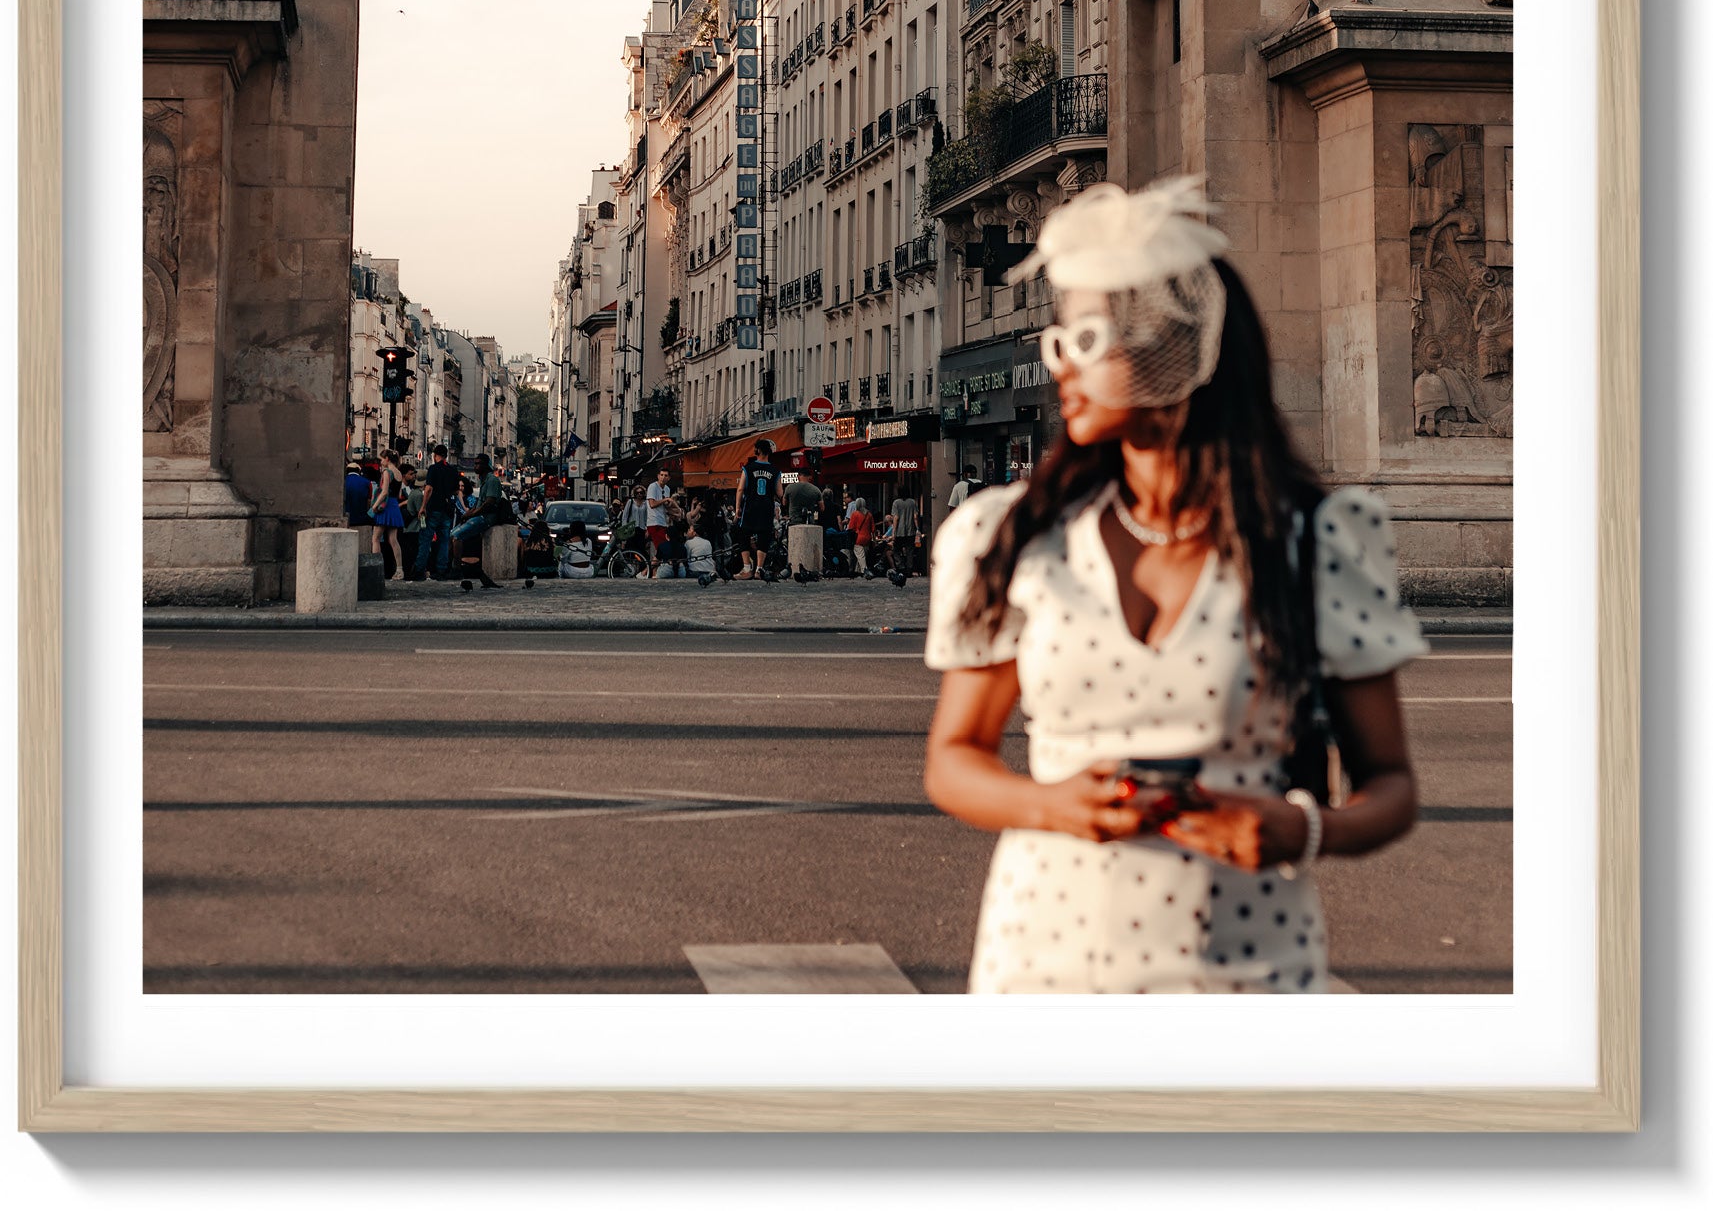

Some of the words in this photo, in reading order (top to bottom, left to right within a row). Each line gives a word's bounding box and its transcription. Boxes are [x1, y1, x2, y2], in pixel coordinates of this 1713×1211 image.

[740, 180, 755, 192] DU
[740, 206, 755, 347] PRADO
[969, 374, 984, 393] PORTE
[984, 373, 991, 391] ST
[991, 371, 1006, 390] DENIS
[1013, 362, 1032, 390] OPTIC
[889, 460, 898, 469] du
[899, 460, 918, 469] Kebab
[752, 470, 774, 480] WILLIAMS
[757, 478, 767, 496] 8
